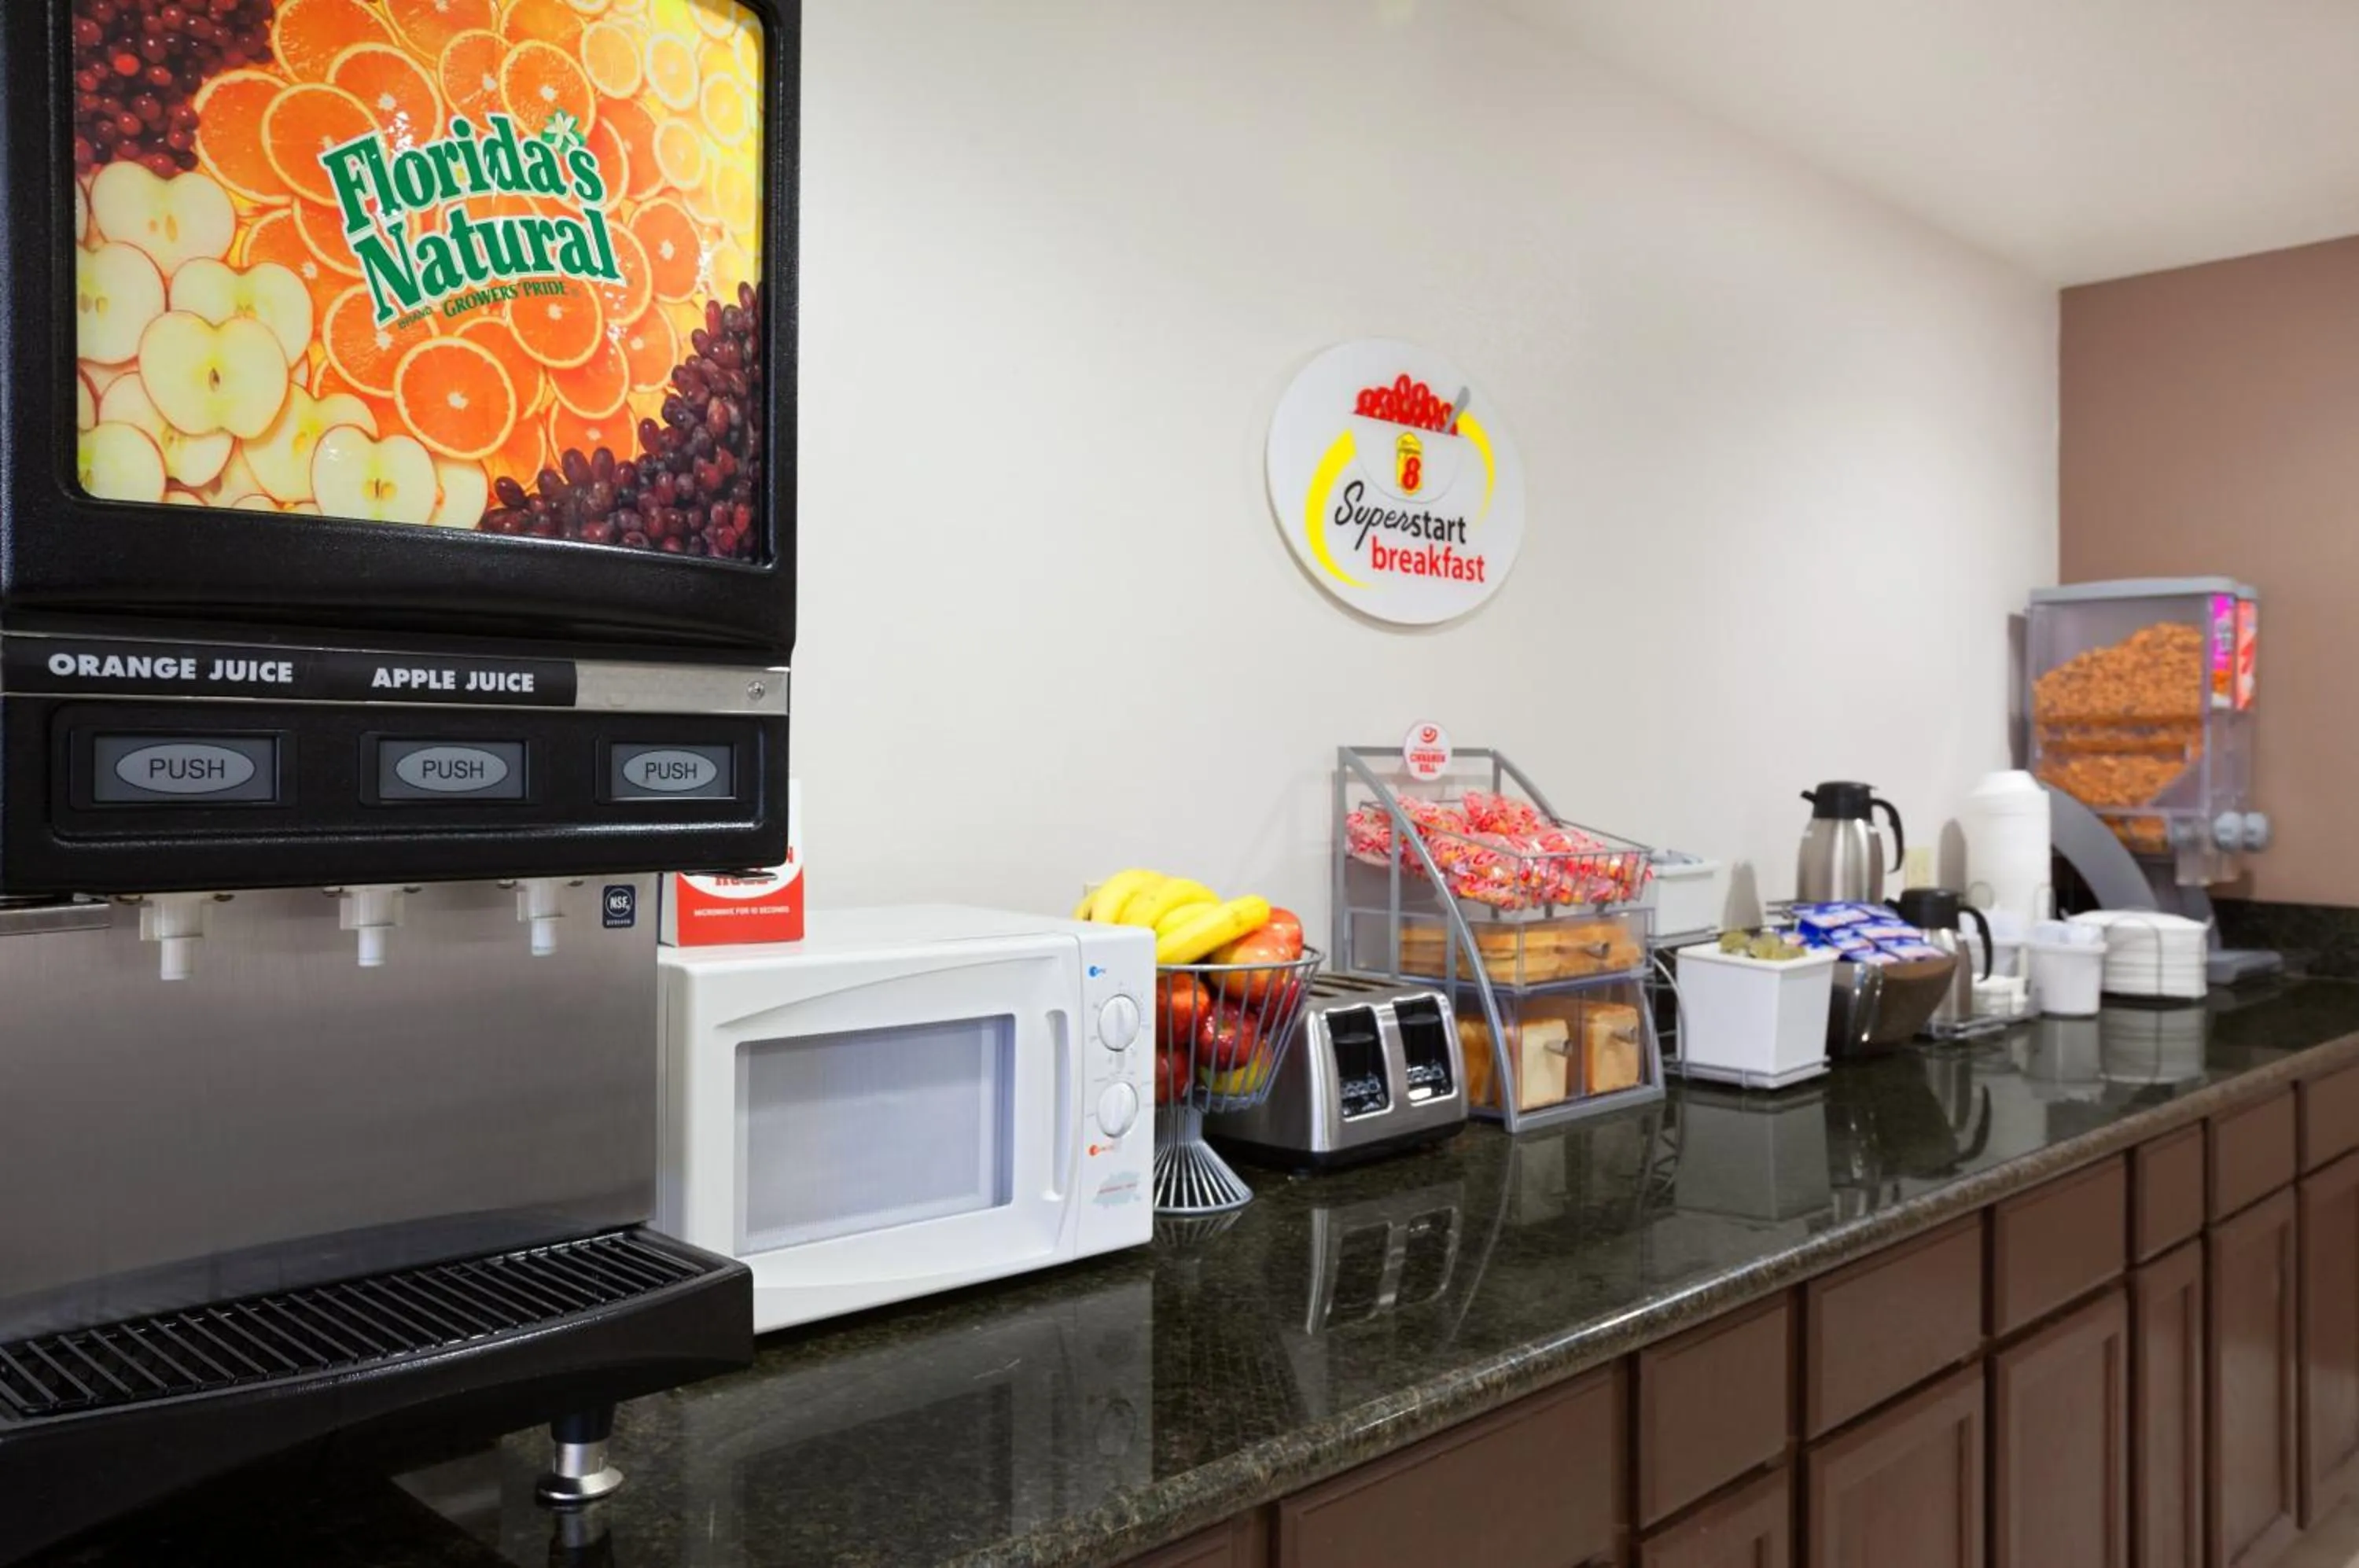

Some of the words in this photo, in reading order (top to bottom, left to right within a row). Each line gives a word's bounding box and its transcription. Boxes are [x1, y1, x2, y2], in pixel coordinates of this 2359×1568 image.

[354, 207, 621, 323] Natural
[523, 281, 567, 298] PRIDE
[1401, 456, 1421, 491] 8
[1371, 535, 1485, 583] breakfast
[48, 653, 197, 679] ORANGE
[208, 659, 293, 683] JUICE
[371, 667, 456, 690] APPLE
[465, 671, 535, 693] JUICE
[148, 757, 226, 781] PUSH
[422, 760, 485, 780] PUSH
[645, 762, 698, 781] PUSH
[610, 896, 628, 909] NSF
